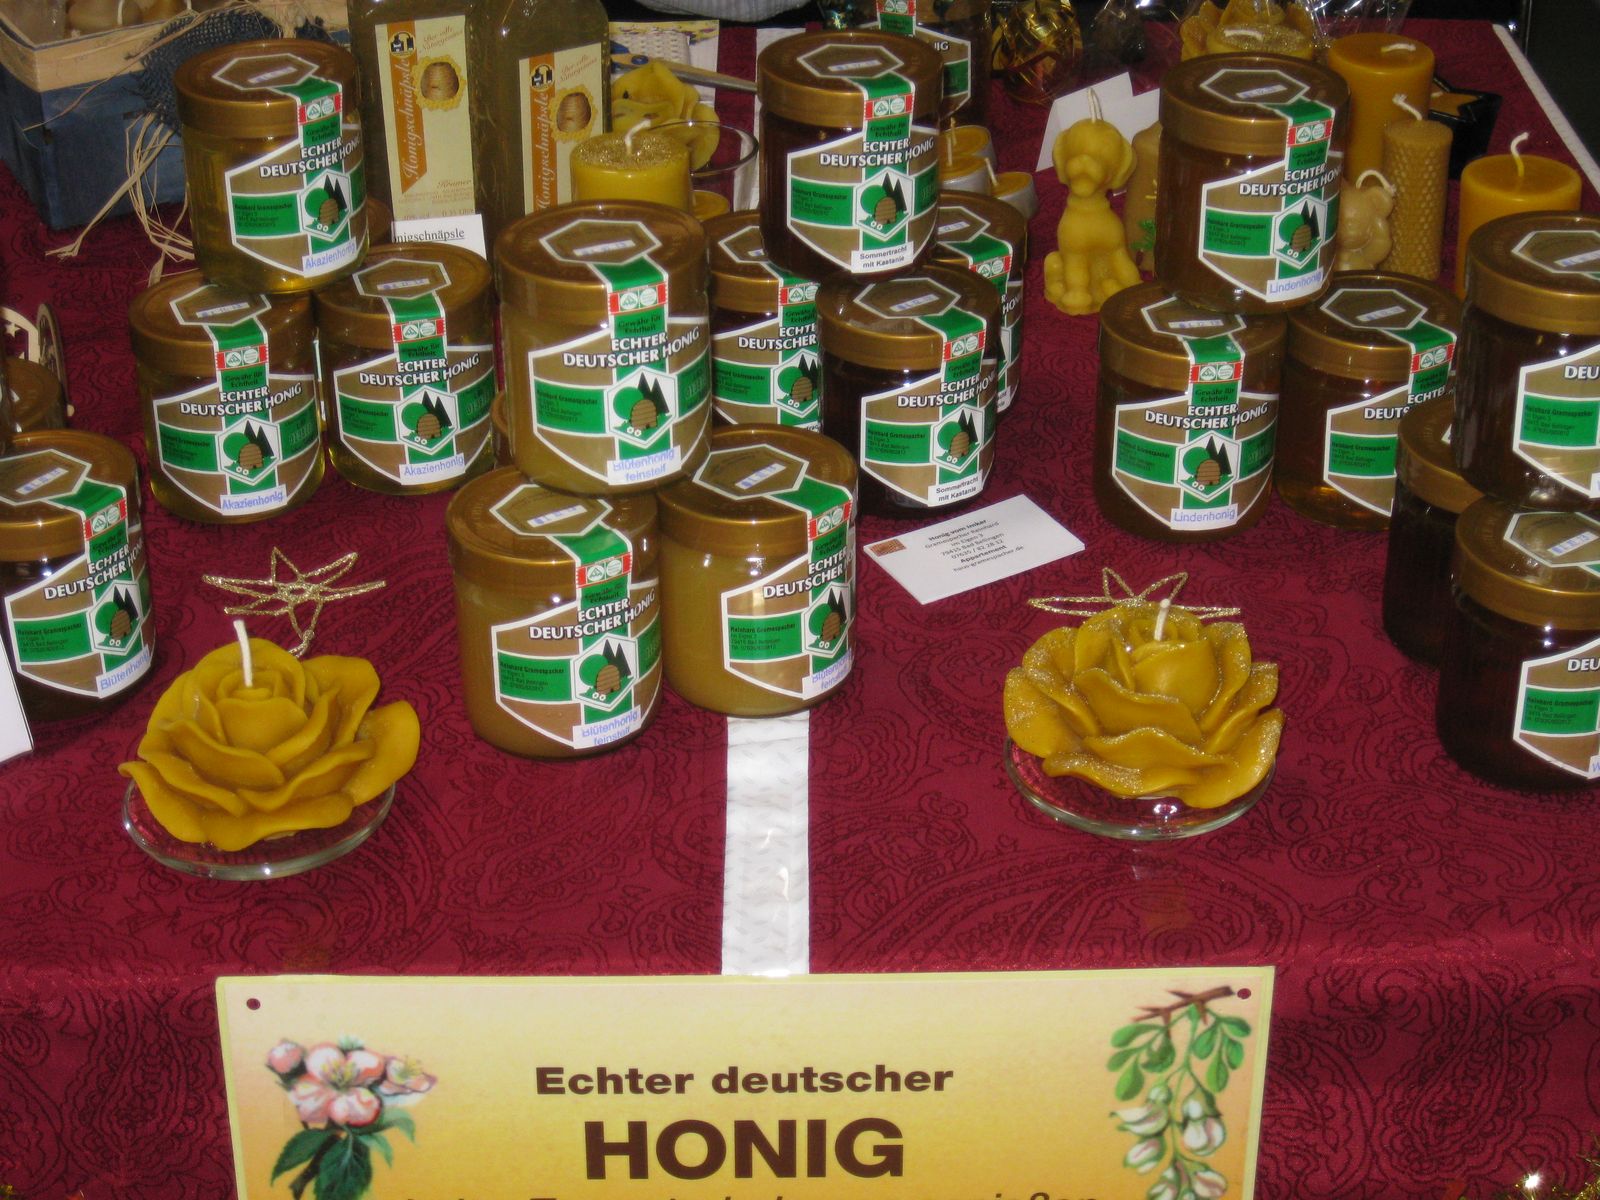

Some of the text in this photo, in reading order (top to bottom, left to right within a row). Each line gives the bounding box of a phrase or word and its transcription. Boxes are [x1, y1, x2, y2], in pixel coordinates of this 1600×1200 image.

[301, 137, 342, 158] ECHTER
[820, 137, 934, 167] DEUTSCHER HONIG
[863, 138, 909, 152] ECHTER
[260, 153, 337, 178] DEUTSCHER
[1285, 165, 1326, 181] ECHTER
[1239, 178, 1318, 196] DEUTSCHER
[862, 260, 875, 268] mit
[563, 326, 700, 368] DEUTSCHER HONIG
[611, 333, 666, 351] ECHTER
[738, 334, 817, 350] DEUTSCHER
[359, 353, 480, 386] DEUTSCHER HONIG
[397, 358, 446, 373] ECHTER
[220, 386, 269, 402] ECHTER
[941, 374, 980, 393] ECHTER
[180, 382, 302, 416] DEUTSCHER HONIG
[897, 389, 974, 408] DEUTSCHER
[1188, 404, 1237, 416] ECHTER
[1145, 402, 1268, 430] DEUTSCHER HONIG
[938, 493, 950, 502] mit
[1174, 508, 1236, 523] Lindenhonig
[88, 545, 129, 574] ECHTER
[808, 547, 846, 575] ECHTER
[44, 561, 126, 600] DEUTSCHER
[763, 566, 842, 599] DEUTSCHER
[530, 587, 656, 640] DEUTSCHER HONIG
[578, 598, 629, 623] ECHTER
[535, 1064, 955, 1095] Echter deutscher
[584, 1117, 905, 1180] HONIG
